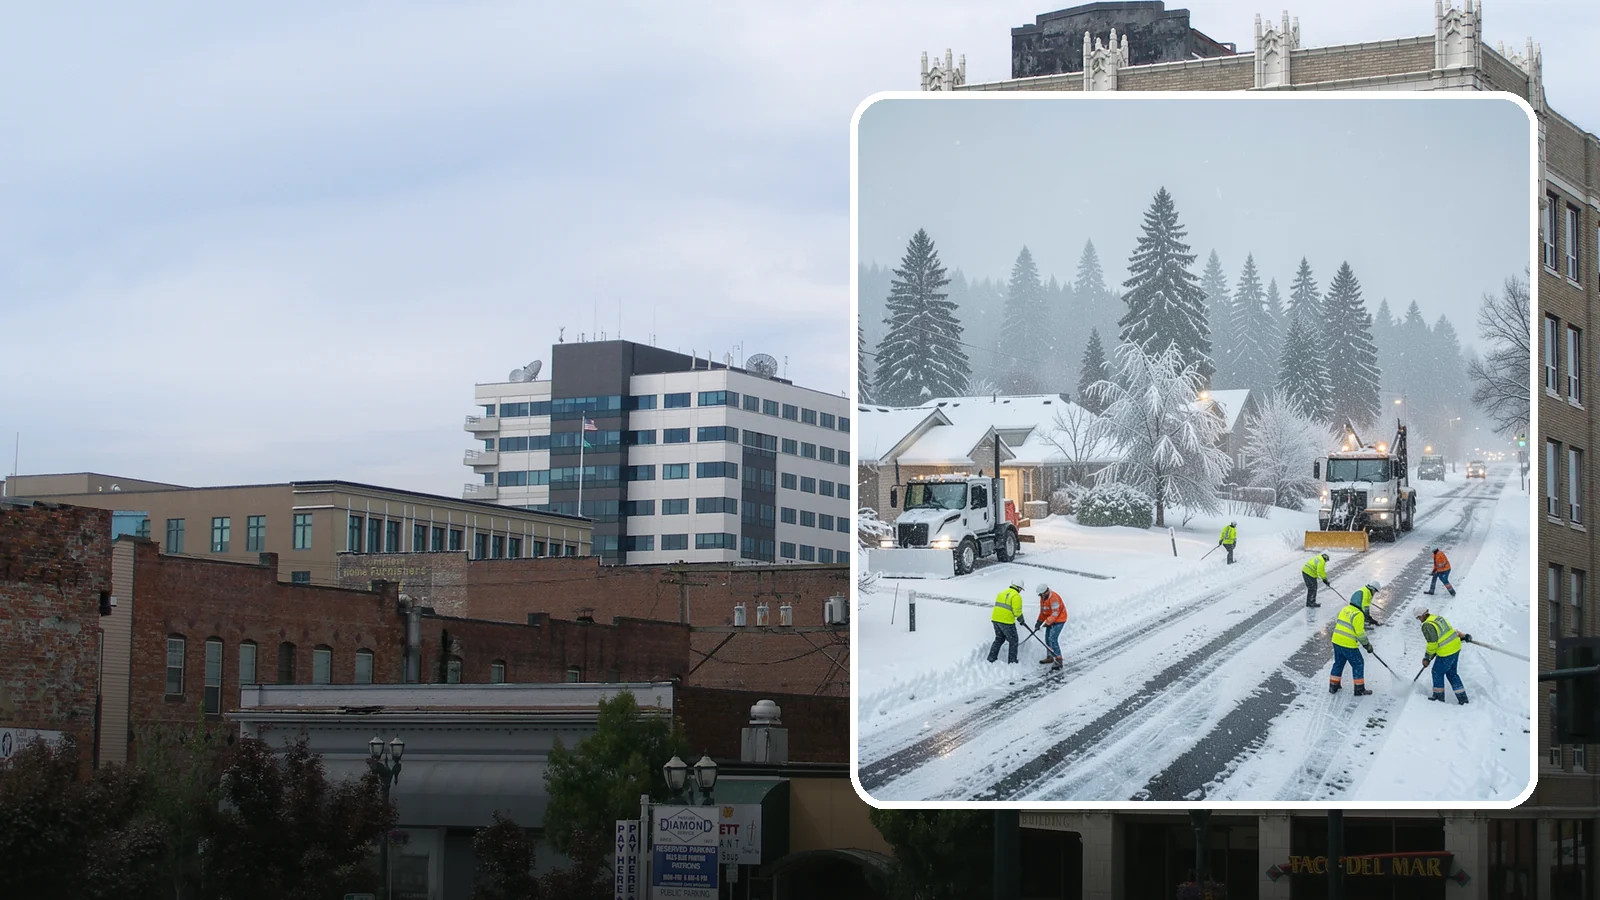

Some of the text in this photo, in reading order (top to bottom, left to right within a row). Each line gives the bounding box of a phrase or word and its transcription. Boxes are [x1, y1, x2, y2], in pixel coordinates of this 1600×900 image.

[343, 566, 427, 577] Home Furnishers
[660, 818, 713, 832] DIAMOND
[1022, 814, 1069, 828] BUILDING
[655, 845, 716, 854] RESERVED PARKING
[616, 825, 625, 893] PAY HERE
[627, 824, 637, 893] PAY HERE
[721, 851, 739, 862] Soup
[671, 861, 701, 869] PATRONS
[1345, 856, 1385, 876] DEL
[1392, 857, 1442, 877] MAR
[660, 888, 710, 898] PUBLIC PARKING
